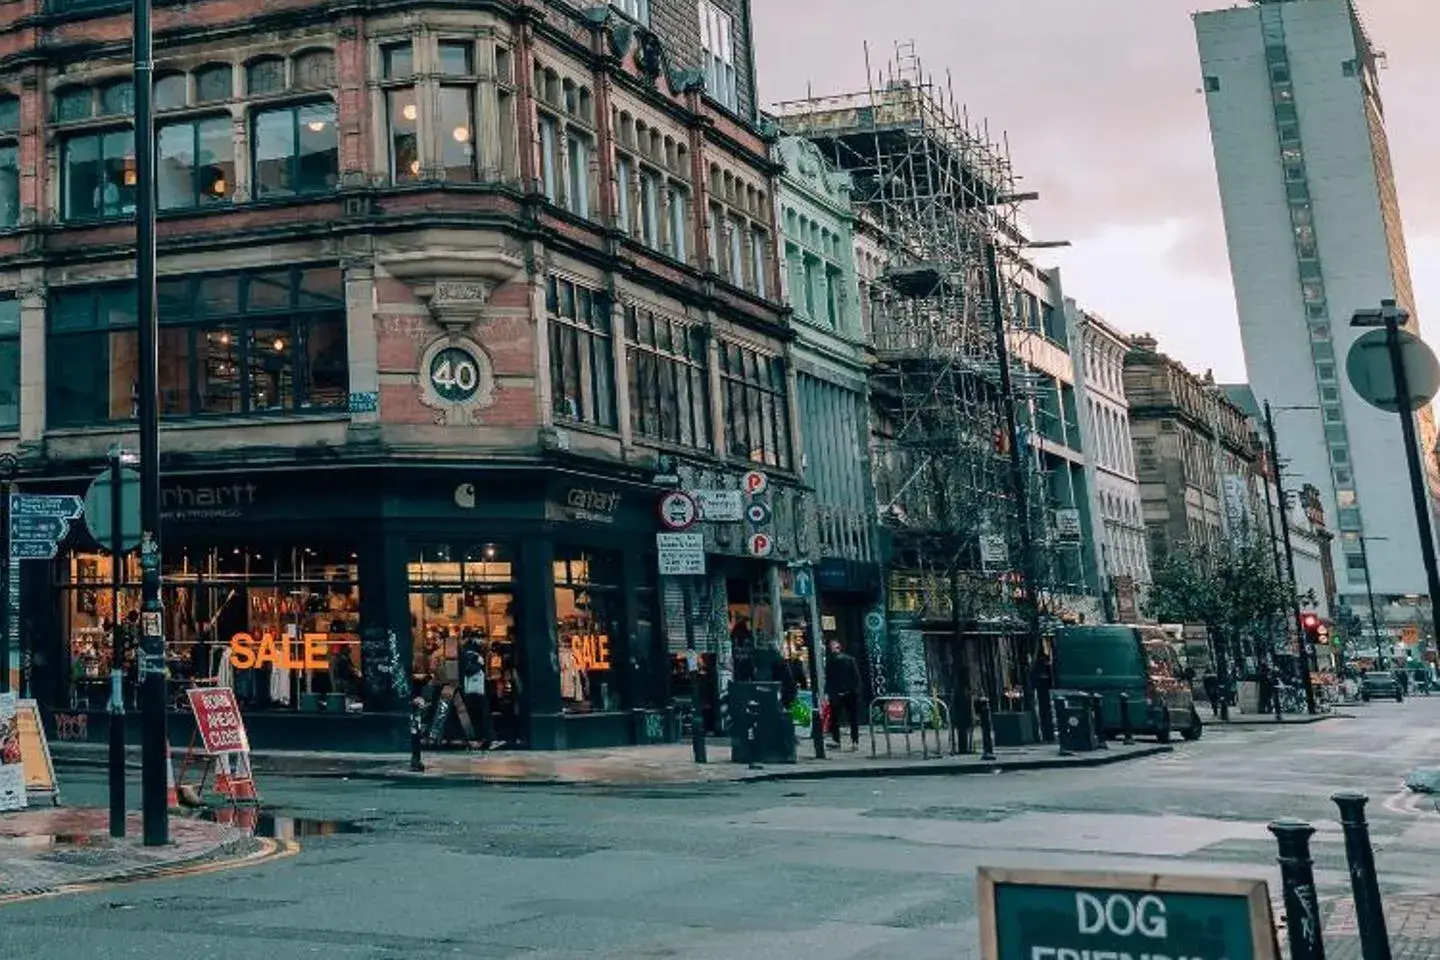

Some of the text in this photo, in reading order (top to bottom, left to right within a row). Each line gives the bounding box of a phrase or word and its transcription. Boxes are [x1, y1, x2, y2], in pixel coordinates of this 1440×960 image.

[431, 360, 478, 391] 40
[161, 484, 258, 507] rhartt
[230, 632, 329, 669] SALE
[571, 635, 609, 670] SALE
[1074, 891, 1168, 938] DOG
